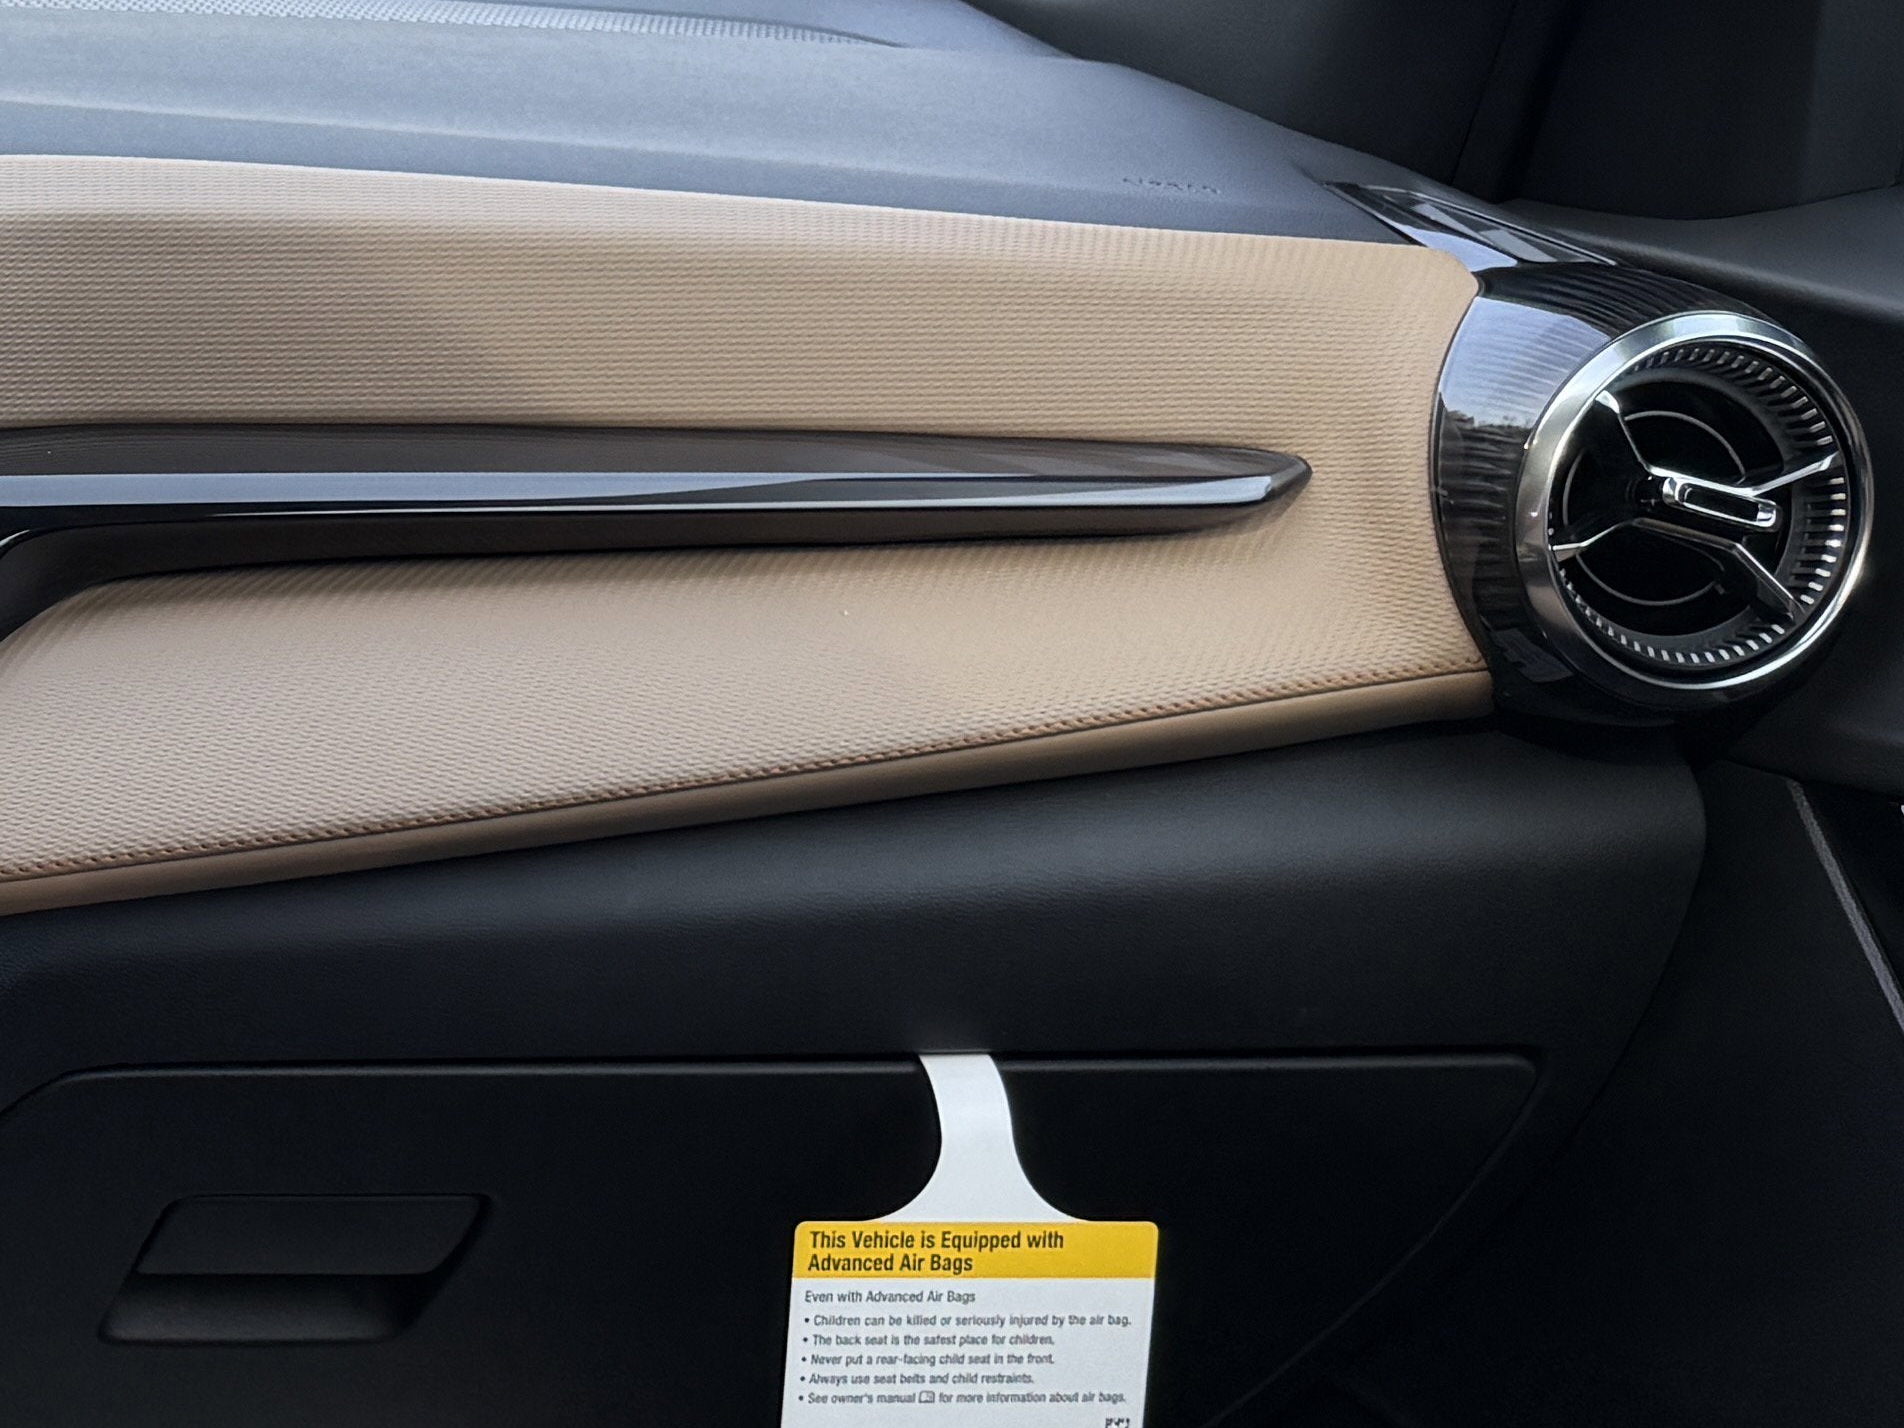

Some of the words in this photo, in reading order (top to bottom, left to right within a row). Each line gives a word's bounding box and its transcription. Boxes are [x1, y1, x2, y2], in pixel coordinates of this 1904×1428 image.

[810, 1230, 846, 1249] This
[851, 1230, 915, 1249] Vehicle
[921, 1230, 935, 1249] is
[941, 1230, 1021, 1252] Equipped
[1027, 1230, 1064, 1249] with
[807, 1253, 894, 1271] Advanced
[899, 1253, 925, 1271] Air
[930, 1254, 973, 1275] Bags
[804, 1290, 834, 1303] Even
[837, 1290, 863, 1303] with
[865, 1290, 924, 1303] Advanced
[927, 1290, 944, 1303] Air
[947, 1290, 976, 1305] Bags
[813, 1314, 861, 1327] Children
[864, 1316, 885, 1327] can
[888, 1314, 903, 1327] be
[906, 1314, 937, 1327] killed
[940, 1316, 952, 1327] or
[955, 1314, 1006, 1328] seriously
[1009, 1314, 1049, 1328] injured
[1052, 1315, 1066, 1328] by
[1068, 1314, 1085, 1327] the
[1089, 1314, 1104, 1327] air
[812, 1334, 832, 1346] The
[835, 1334, 861, 1346] back
[864, 1334, 888, 1346] seat
[891, 1334, 900, 1346] is
[903, 1334, 920, 1346] the
[923, 1334, 956, 1346] safest
[959, 1334, 988, 1347] place
[991, 1334, 1006, 1346] for
[810, 1354, 842, 1365] Never
[845, 1354, 864, 1367] put
[866, 1356, 873, 1365] a
[875, 1354, 936, 1367] rear-facing
[939, 1354, 965, 1365] child
[967, 1354, 991, 1365] seat
[993, 1354, 1004, 1365] in
[1007, 1354, 1024, 1365] the
[809, 1373, 848, 1387] Always
[851, 1375, 870, 1385] use
[873, 1373, 897, 1385] seat
[900, 1373, 926, 1385] belts
[929, 1373, 949, 1385] and
[951, 1373, 978, 1385] child
[807, 1392, 828, 1404] See
[876, 1392, 916, 1404] manual
[938, 1392, 953, 1404] for
[955, 1394, 984, 1404] more
[986, 1392, 1047, 1404] information
[1049, 1392, 1079, 1404] about
[1081, 1392, 1096, 1404] air
